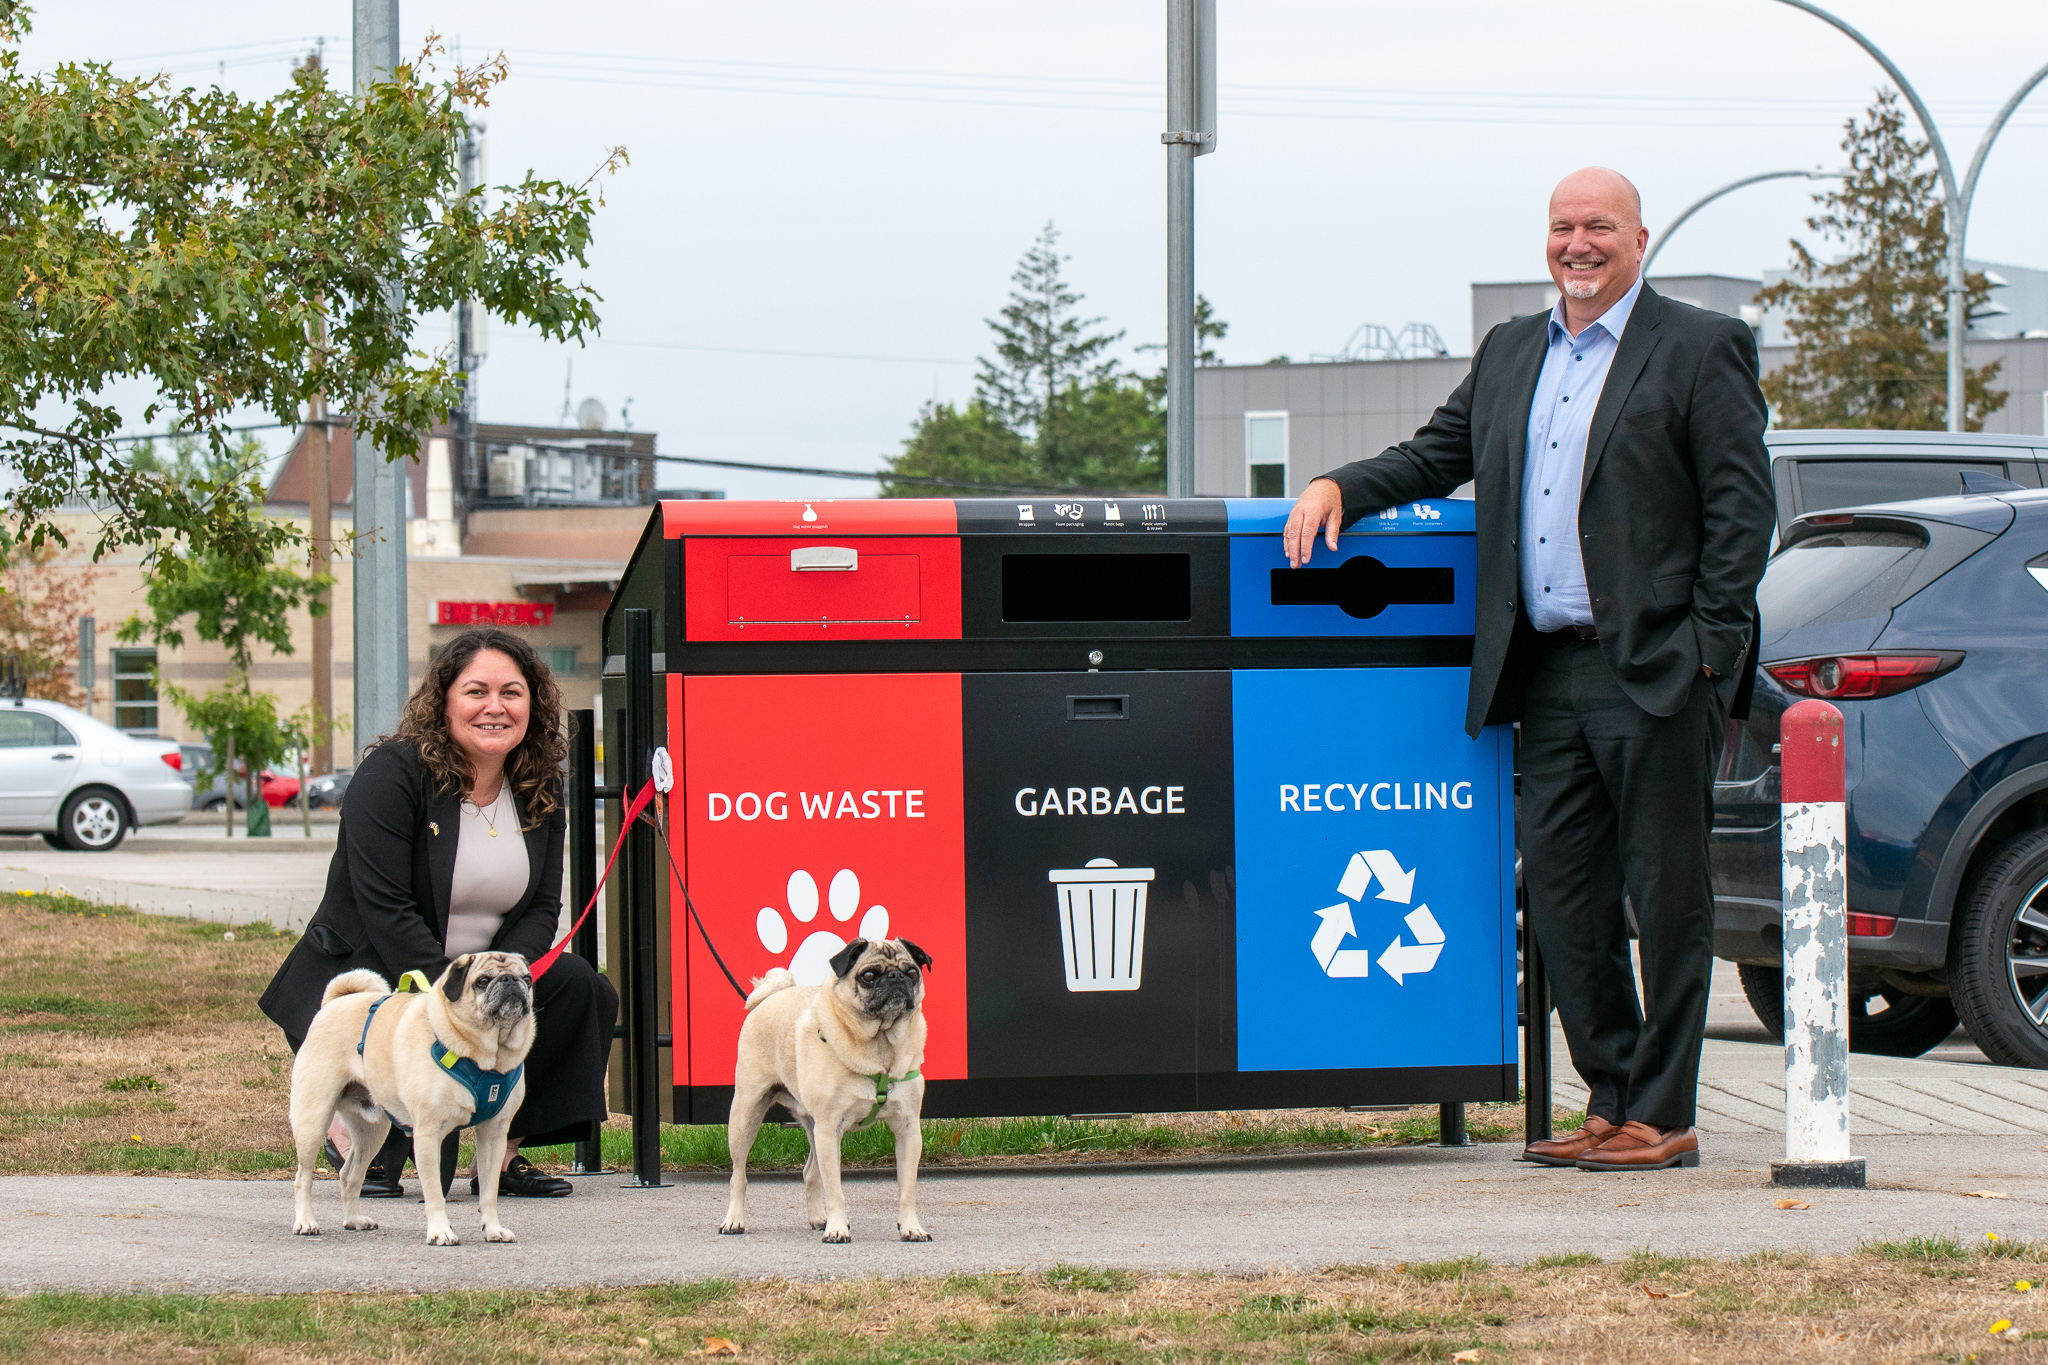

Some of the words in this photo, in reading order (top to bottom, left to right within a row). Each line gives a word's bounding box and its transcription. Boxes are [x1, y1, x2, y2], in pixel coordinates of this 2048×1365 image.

[708, 791, 788, 822] DOG
[799, 789, 925, 820] WASTE
[1015, 785, 1185, 817] GARBAGE
[1279, 781, 1473, 812] RECYCLING
[1987, 899, 2006, 1011] CONTINENTAL
